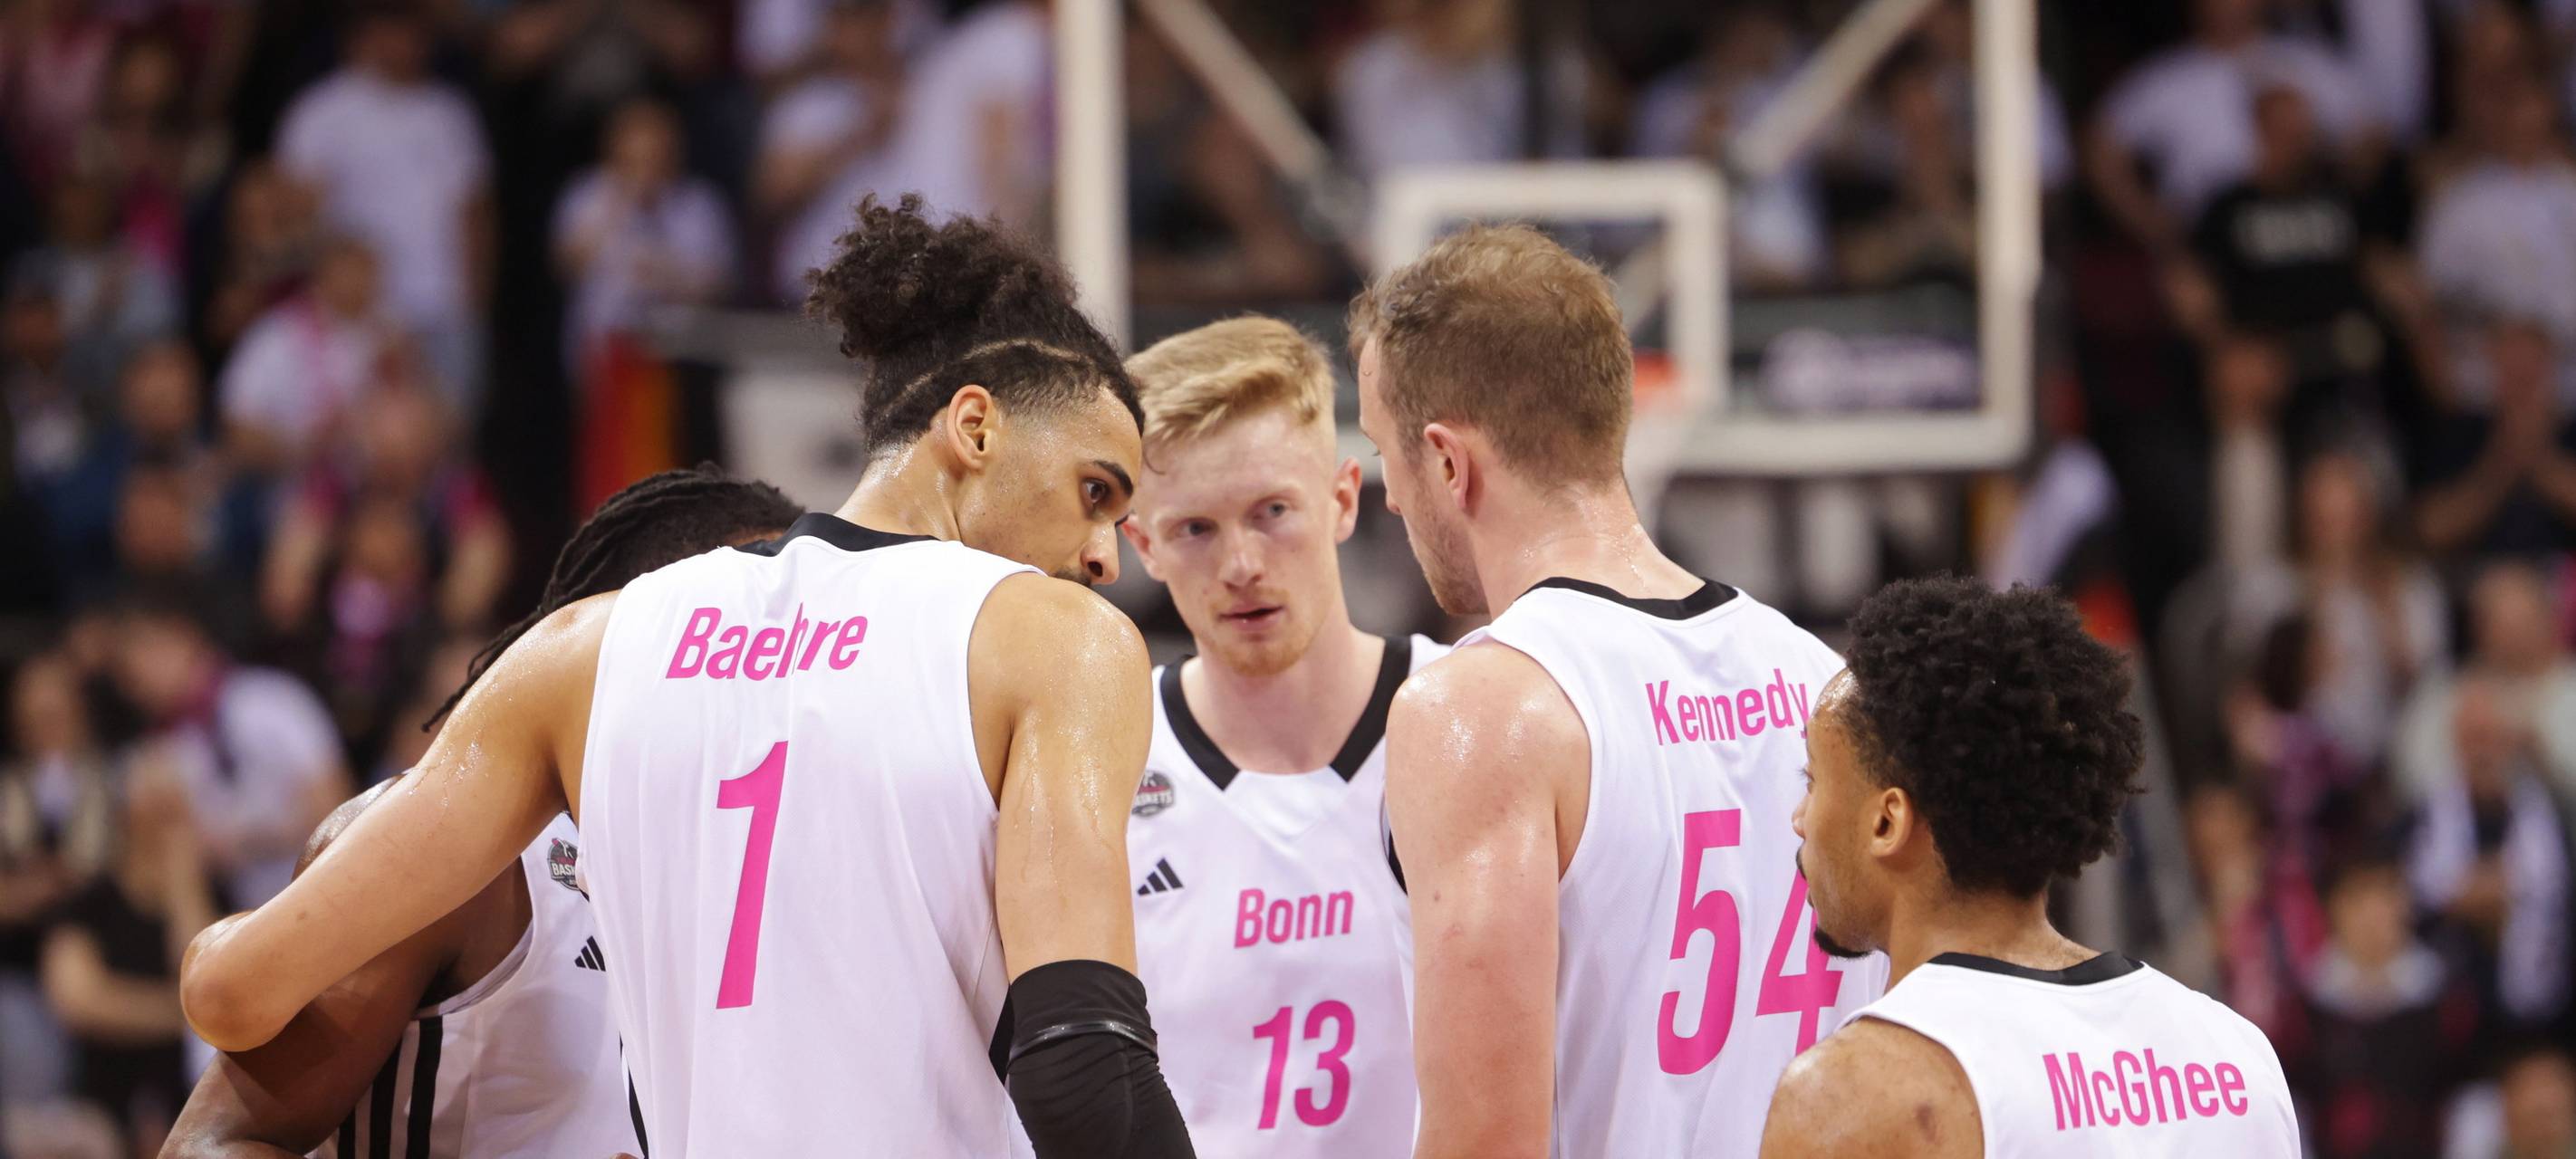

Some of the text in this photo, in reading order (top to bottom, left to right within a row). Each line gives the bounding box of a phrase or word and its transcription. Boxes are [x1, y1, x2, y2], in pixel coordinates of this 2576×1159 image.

[666, 602, 868, 681] Baehre
[1646, 668, 1810, 746] Kennedy
[716, 741, 789, 1010] 1
[1235, 888, 1354, 949] Bonn
[1657, 809, 1844, 1076] 54
[1253, 1000, 1356, 1130] 13
[2043, 1049, 2248, 1131] McGhee
